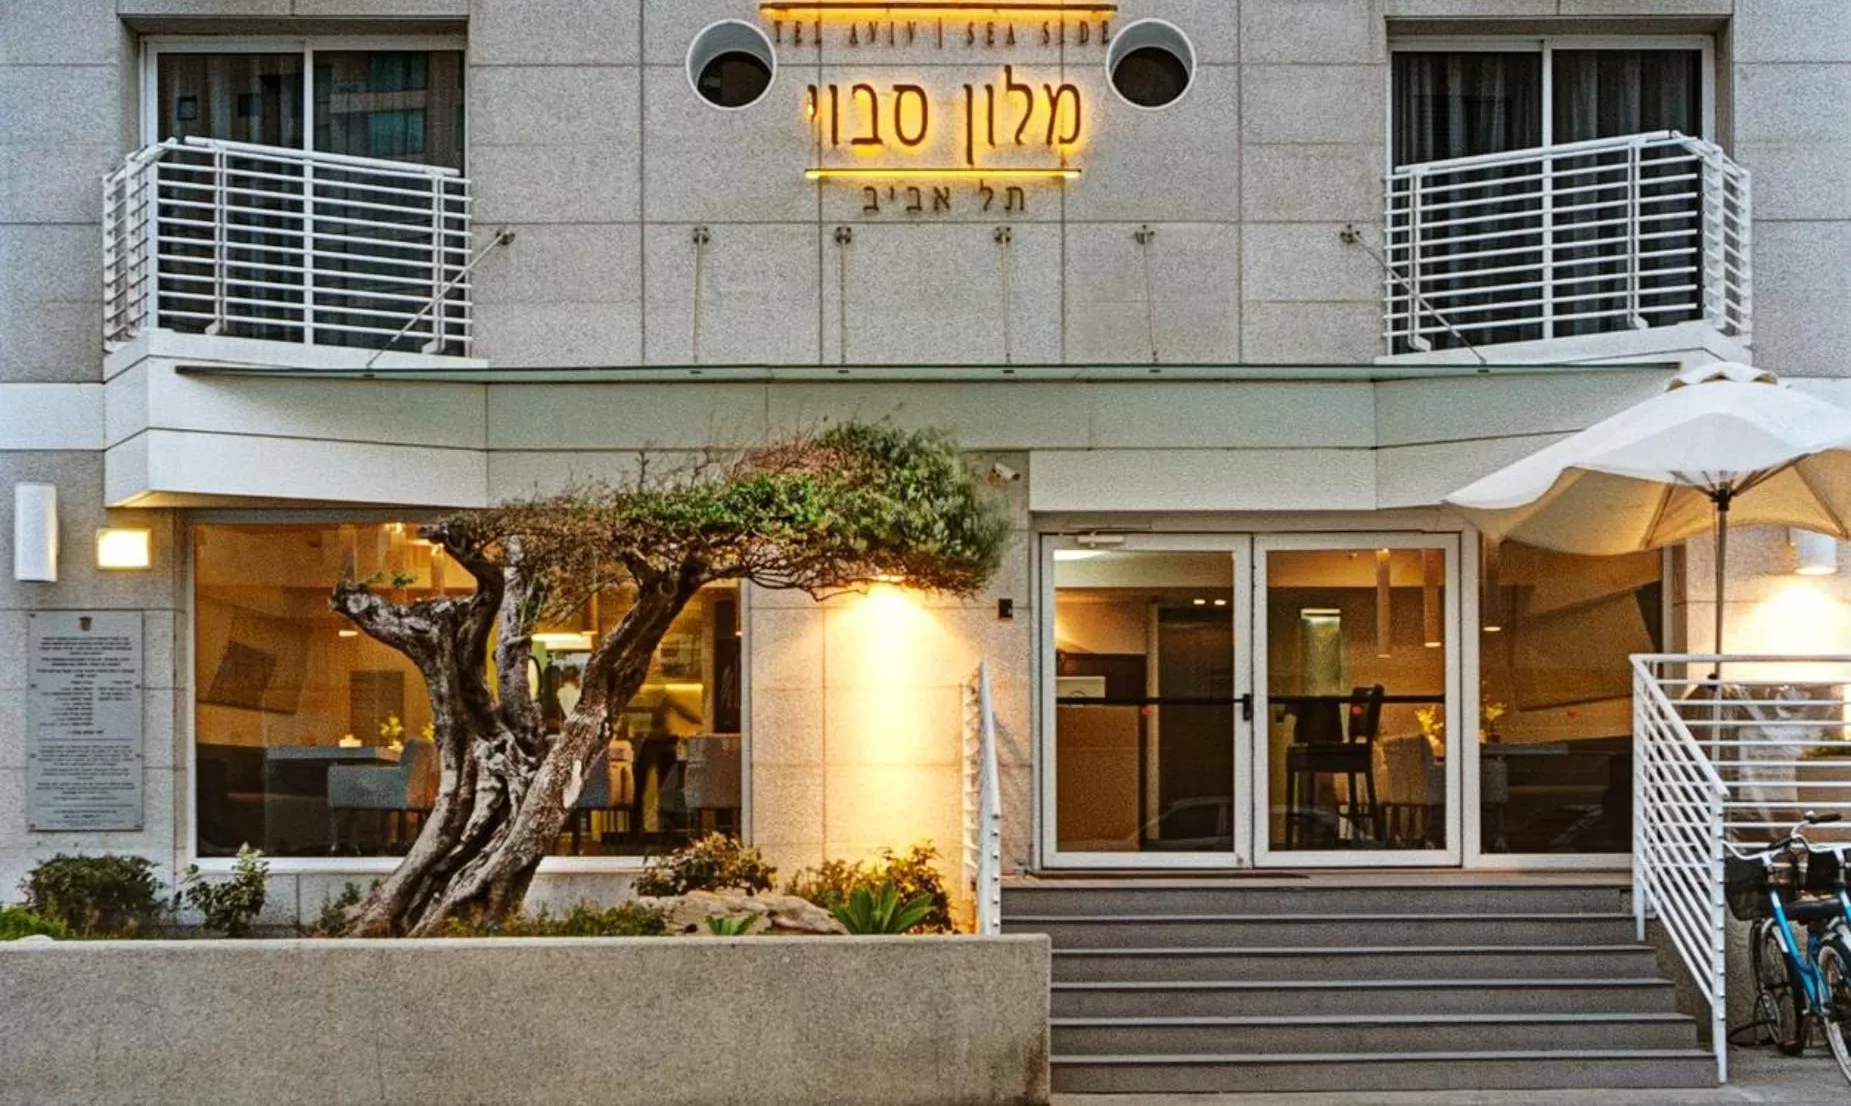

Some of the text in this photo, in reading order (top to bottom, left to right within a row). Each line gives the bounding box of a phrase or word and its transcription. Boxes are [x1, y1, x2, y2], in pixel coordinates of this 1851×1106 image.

[773, 19, 1110, 46] TEL AVIV SEA SIDE
[807, 64, 1082, 167] מלון סבוי
[862, 178, 1026, 213] תל אביב
